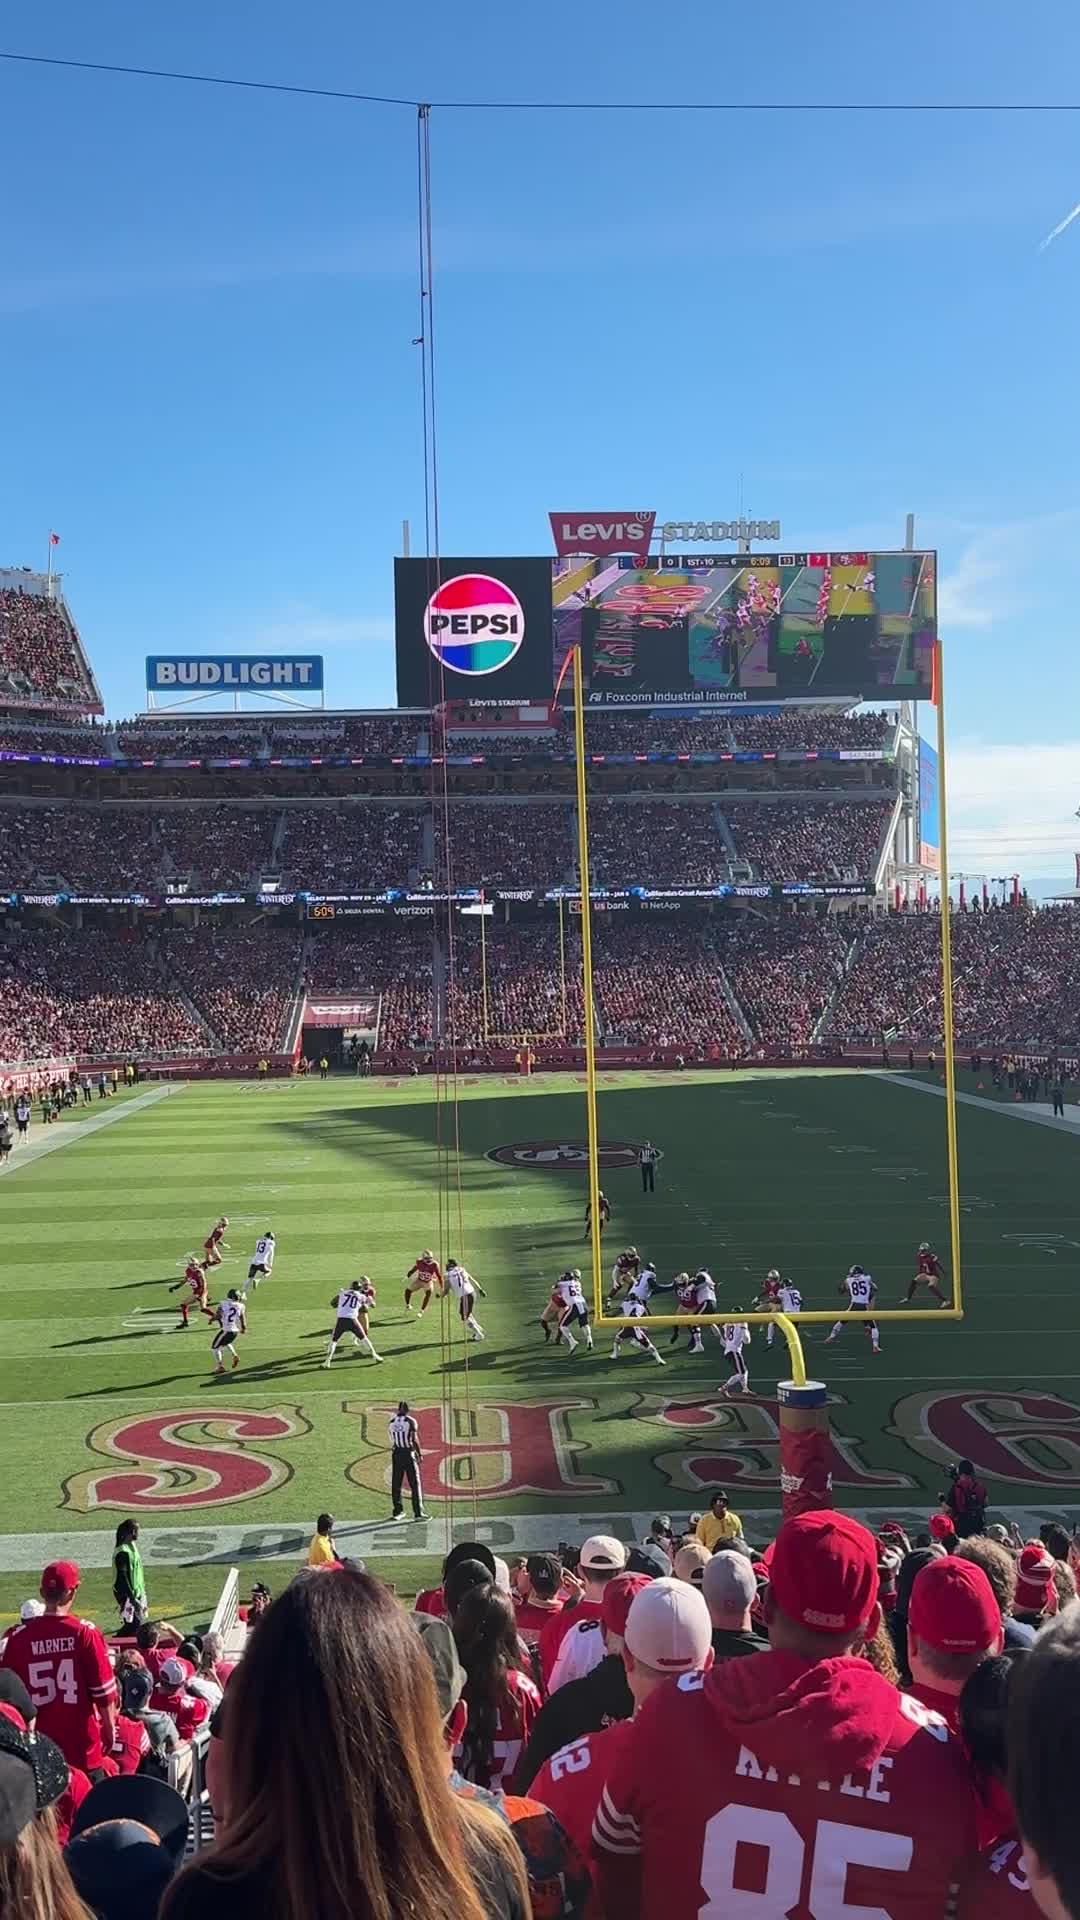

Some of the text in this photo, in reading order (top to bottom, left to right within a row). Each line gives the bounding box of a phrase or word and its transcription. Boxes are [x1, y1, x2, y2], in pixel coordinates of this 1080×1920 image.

[663, 520, 780, 541] STADIUM
[431, 614, 518, 635] PEPSI
[606, 692, 651, 702] Foxconn
[654, 691, 703, 701] Industrial
[706, 691, 748, 701] Internet
[313, 907, 334, 917] 6:09
[393, 906, 434, 915] verizon
[606, 901, 630, 910] bank
[649, 902, 681, 911] NetApp
[256, 1242, 267, 1254] 13
[851, 1280, 867, 1296] 85
[342, 1293, 359, 1309] 70
[789, 1292, 802, 1307] 15
[228, 1307, 237, 1323] 2
[31, 1637, 75, 1655] WARNER
[28, 1658, 77, 1707] 54
[697, 1803, 914, 1920] 85
